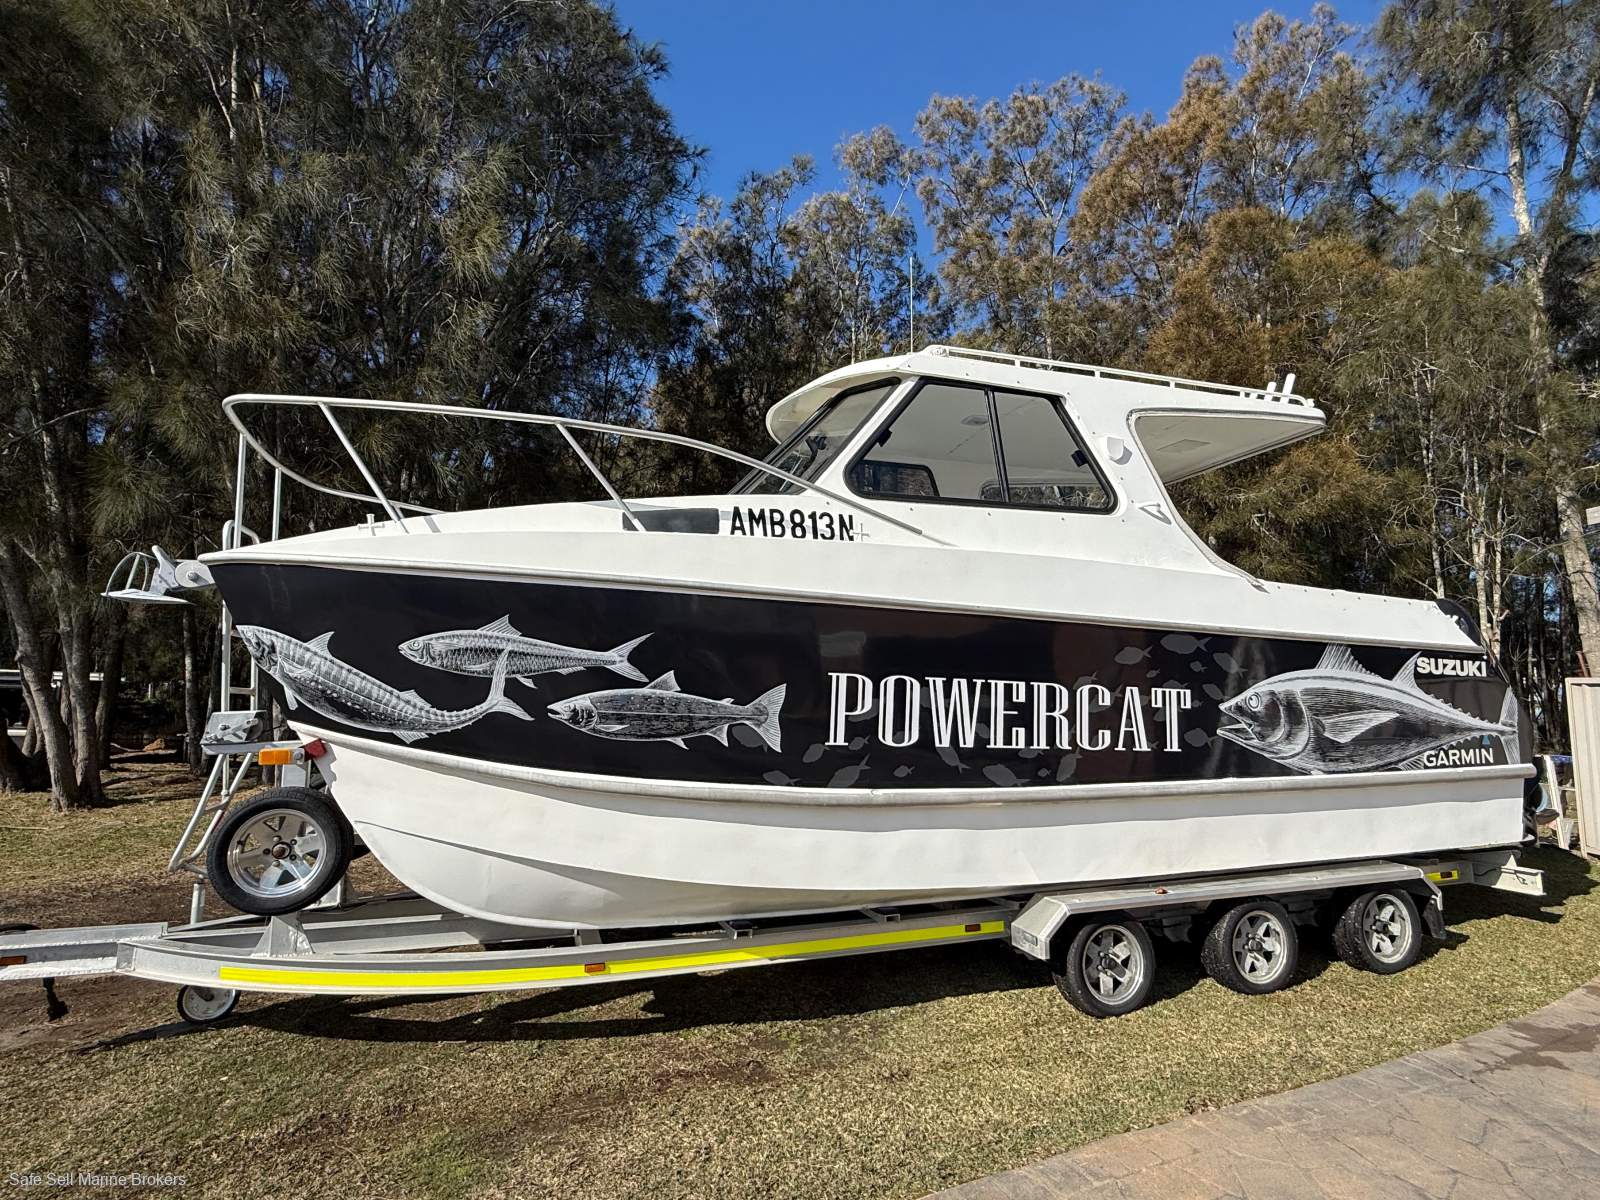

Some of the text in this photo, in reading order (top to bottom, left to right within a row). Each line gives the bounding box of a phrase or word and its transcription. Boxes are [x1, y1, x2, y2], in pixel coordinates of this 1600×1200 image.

[730, 506, 854, 541] AMB813N
[1416, 656, 1487, 677] SUZUKI
[825, 672, 1191, 752] POWERCAT
[1423, 747, 1494, 767] GARMIN
